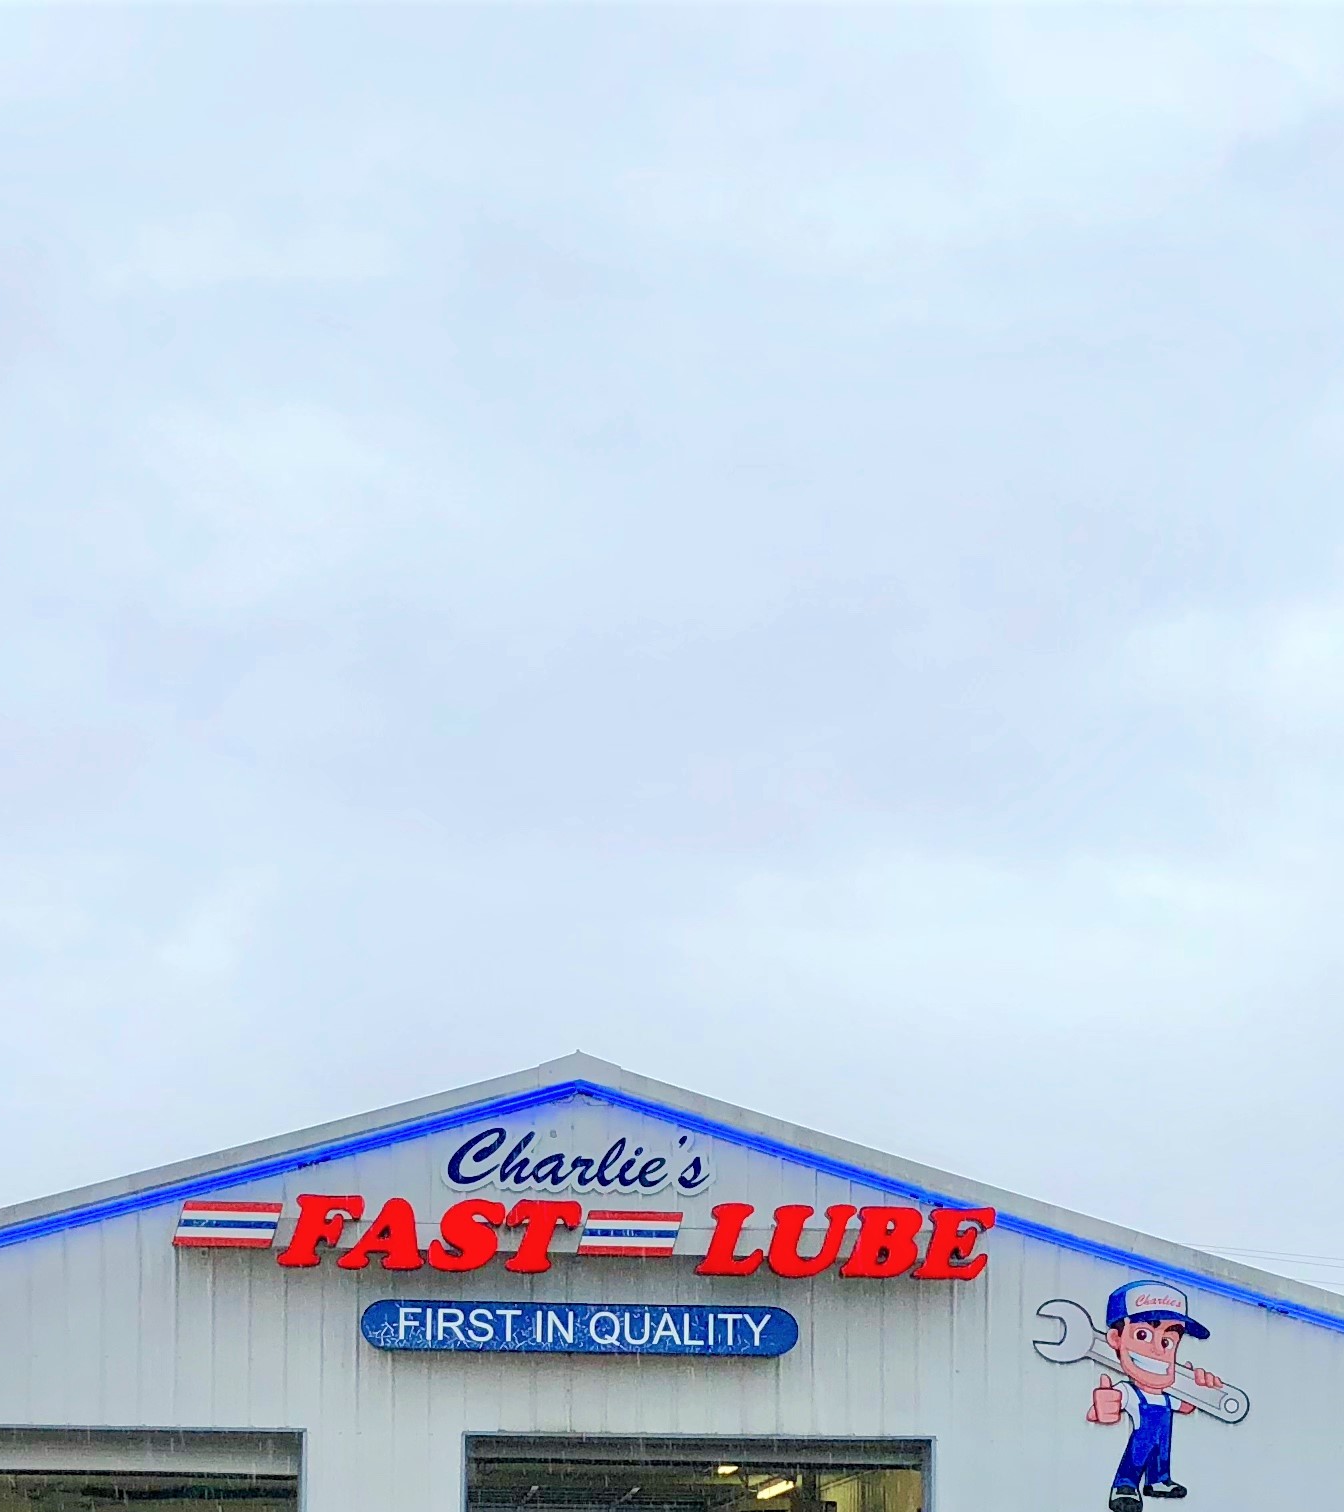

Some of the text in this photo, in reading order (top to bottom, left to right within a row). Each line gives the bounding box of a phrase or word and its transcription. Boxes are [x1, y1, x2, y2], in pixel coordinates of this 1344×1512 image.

[447, 1127, 710, 1189] Charlie's
[277, 1194, 996, 1281] FAST LUBE
[397, 1306, 772, 1348] FIRST IN QUALITY
